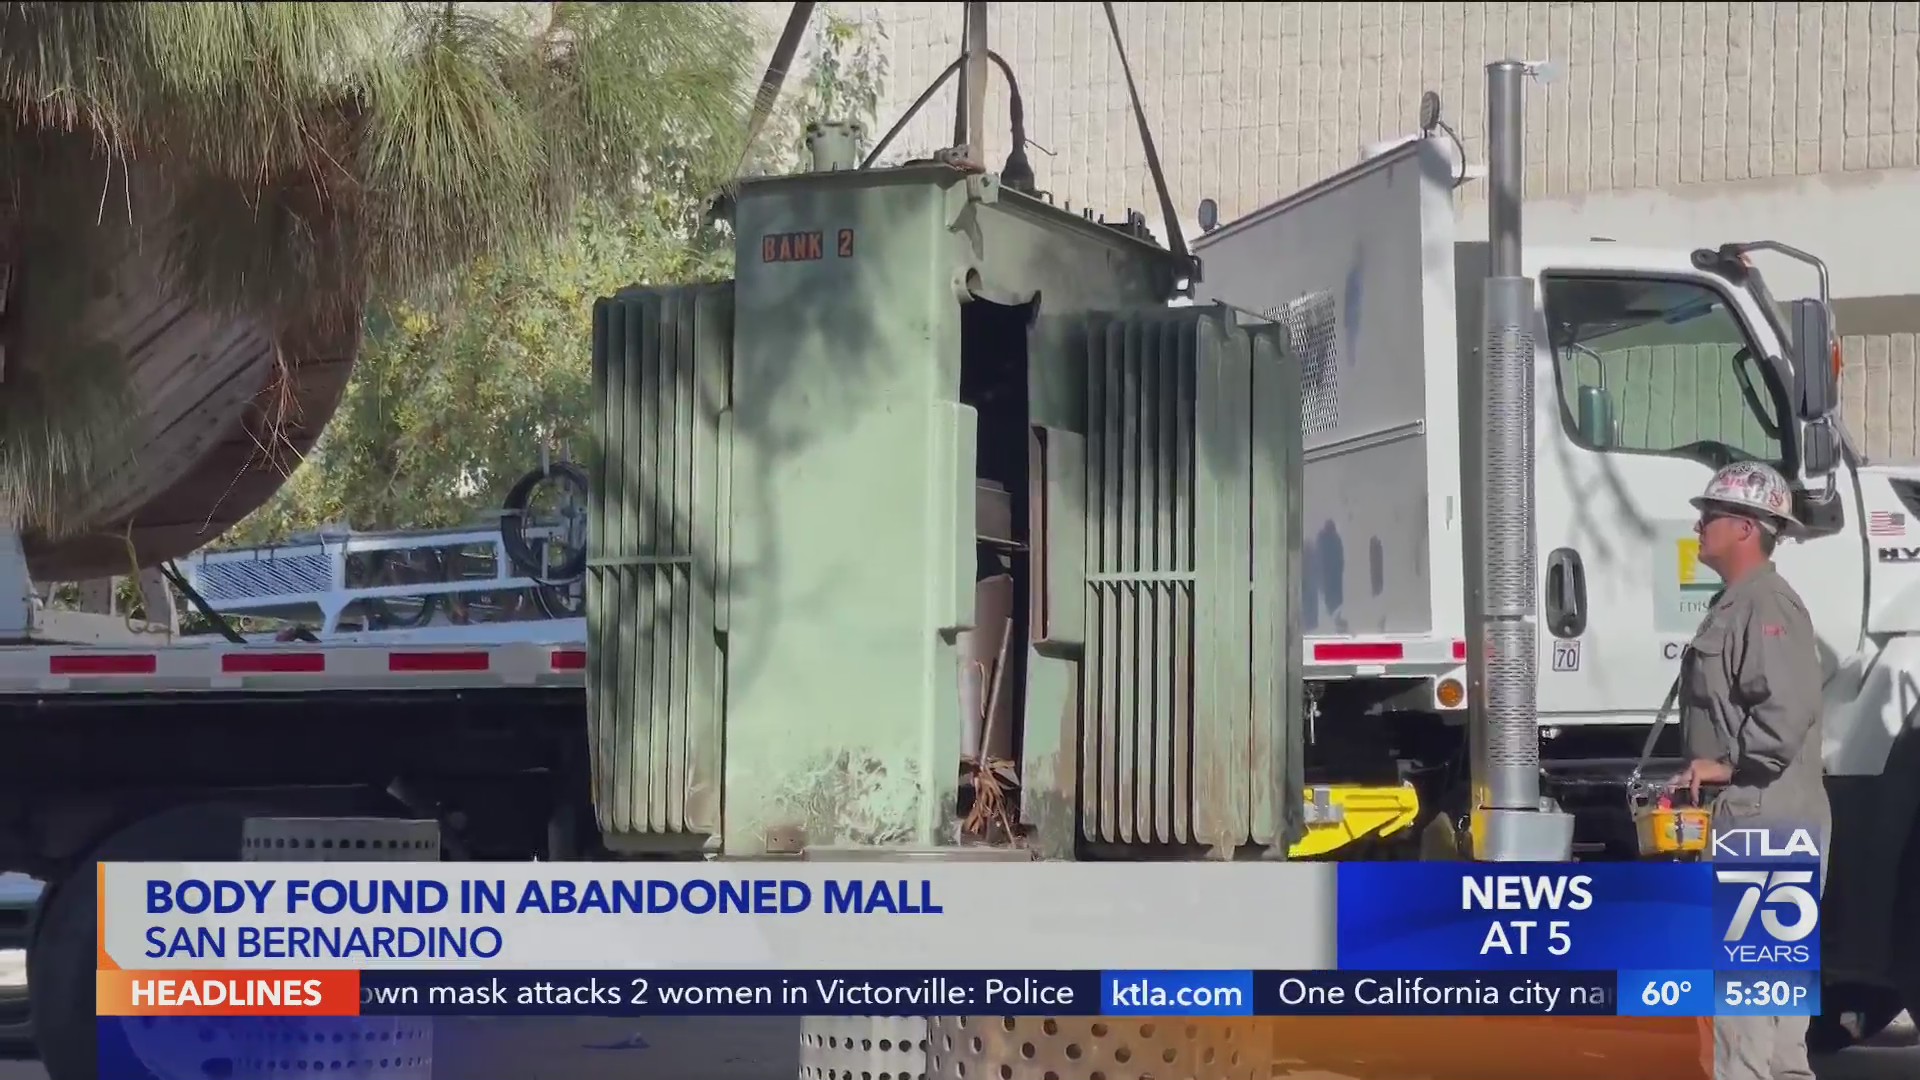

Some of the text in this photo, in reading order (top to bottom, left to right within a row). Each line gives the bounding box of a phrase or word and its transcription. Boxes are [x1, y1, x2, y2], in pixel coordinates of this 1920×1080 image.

[763, 229, 853, 262] BANK 2
[1556, 648, 1577, 668] 70
